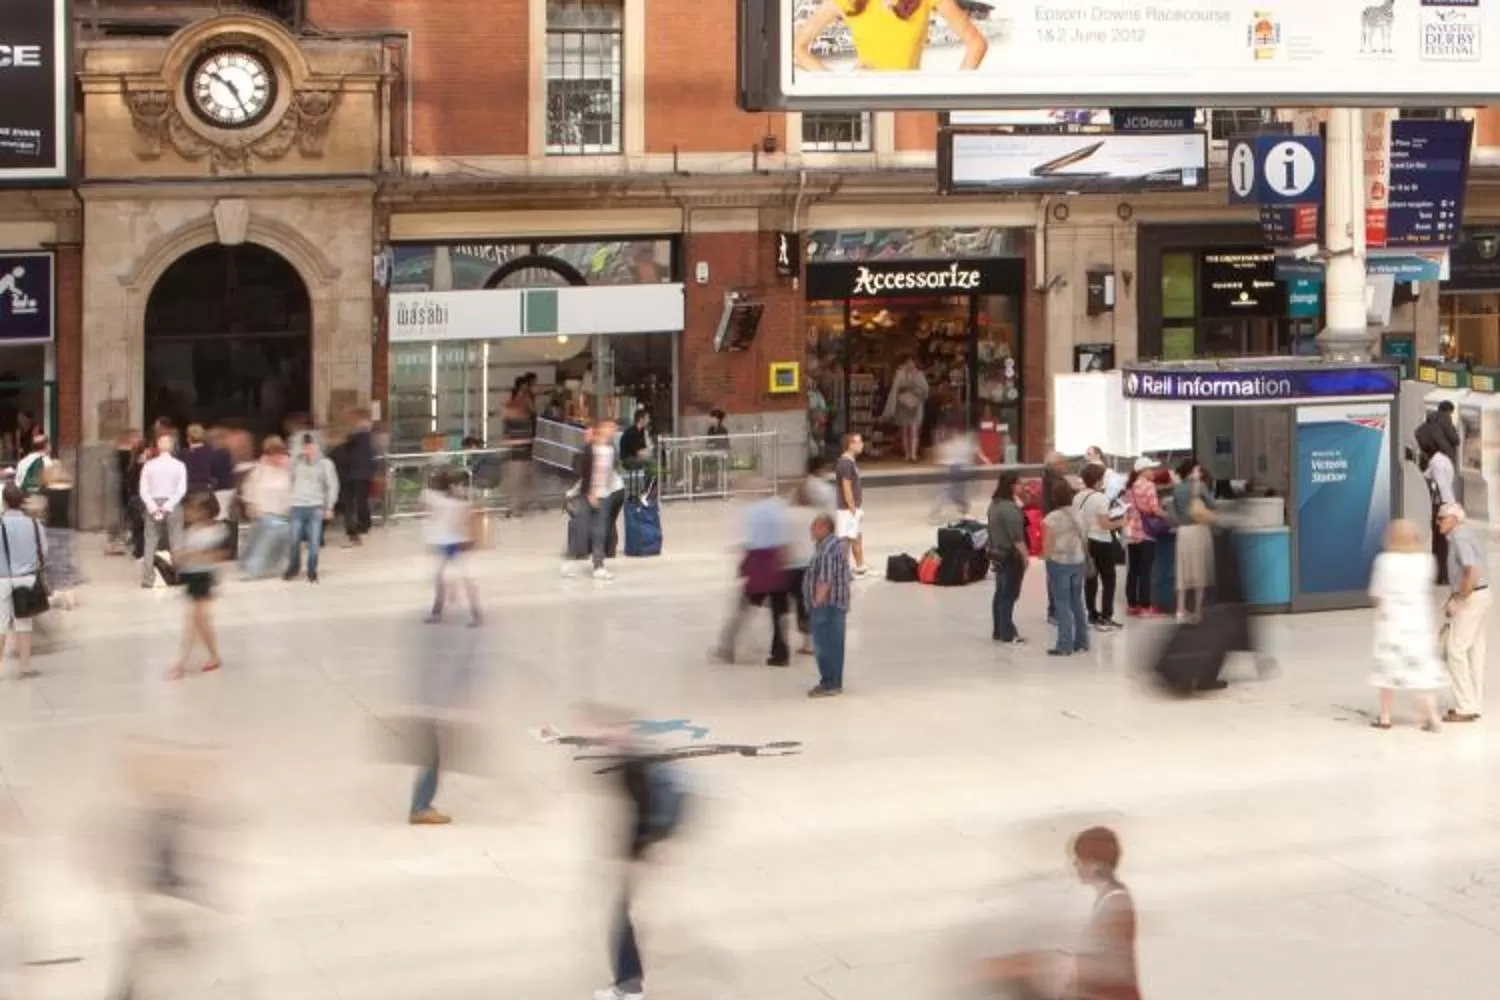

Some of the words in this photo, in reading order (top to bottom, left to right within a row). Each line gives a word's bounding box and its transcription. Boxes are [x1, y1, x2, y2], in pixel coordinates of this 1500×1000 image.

[853, 261, 982, 296] Accessorize
[397, 300, 449, 326] wasabi
[1142, 375, 1172, 396] Rail
[1176, 375, 1292, 397] information
